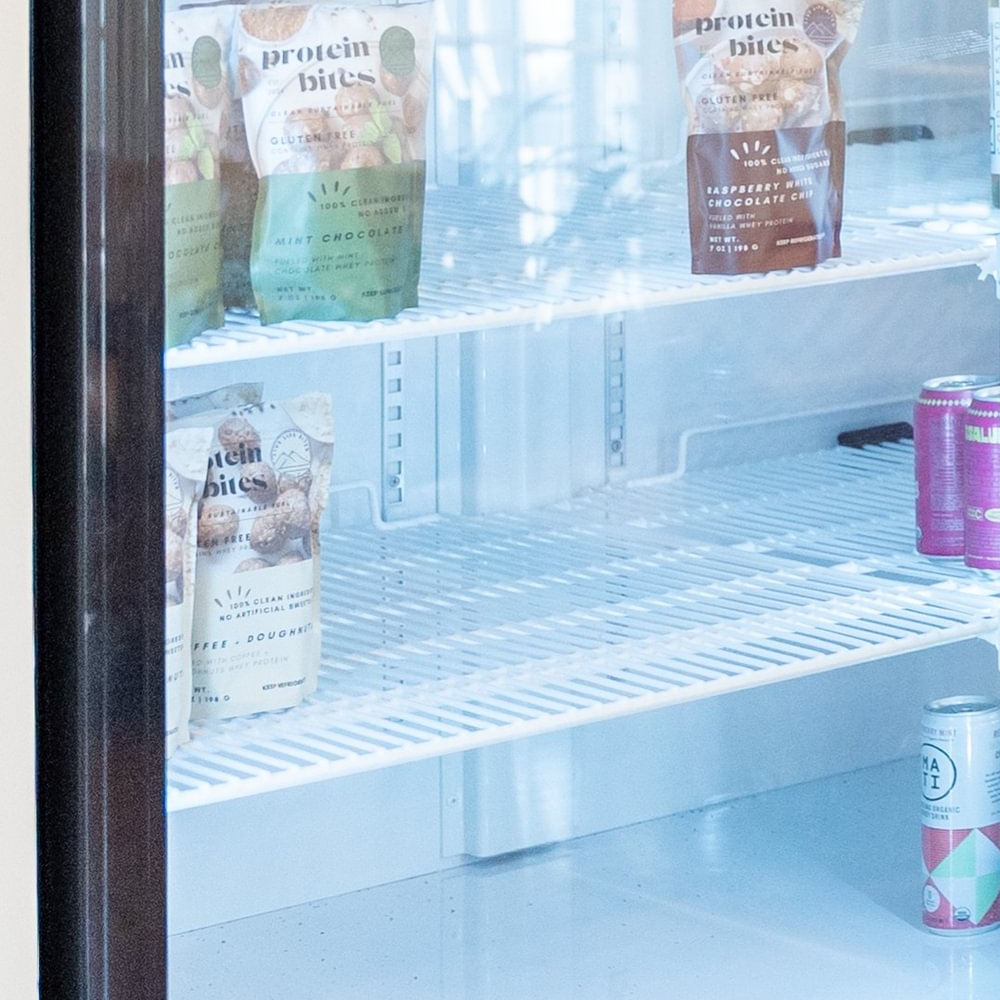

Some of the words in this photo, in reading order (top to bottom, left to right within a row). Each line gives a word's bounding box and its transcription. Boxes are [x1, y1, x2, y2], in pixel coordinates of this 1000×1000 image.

[695, 7, 795, 36] protein
[262, 36, 370, 70] protein
[729, 34, 800, 58] bites
[298, 67, 377, 93] bites
[701, 95, 747, 106] GLUTEN
[752, 92, 778, 101] FREE
[270, 132, 321, 145] GLUTEN
[327, 130, 356, 141] FREE
[744, 158, 767, 168] 100%
[706, 182, 781, 196] RASPBERRY
[786, 176, 813, 190] WHITE
[320, 202, 347, 211] 100%
[707, 193, 786, 208] CHOCOLATE
[791, 189, 814, 201] CHIP
[736, 212, 756, 221] WITH
[739, 220, 763, 229] WHEY
[764, 216, 794, 227] PROTEIN
[274, 234, 314, 246] MINT
[321, 225, 404, 244] CHOCOLATE
[203, 473, 268, 498] bites
[223, 533, 251, 545] FREE
[229, 600, 251, 611] 100%
[253, 594, 284, 606] CLEAN
[219, 613, 233, 623] NO
[235, 605, 285, 620] ARTIFICIAL
